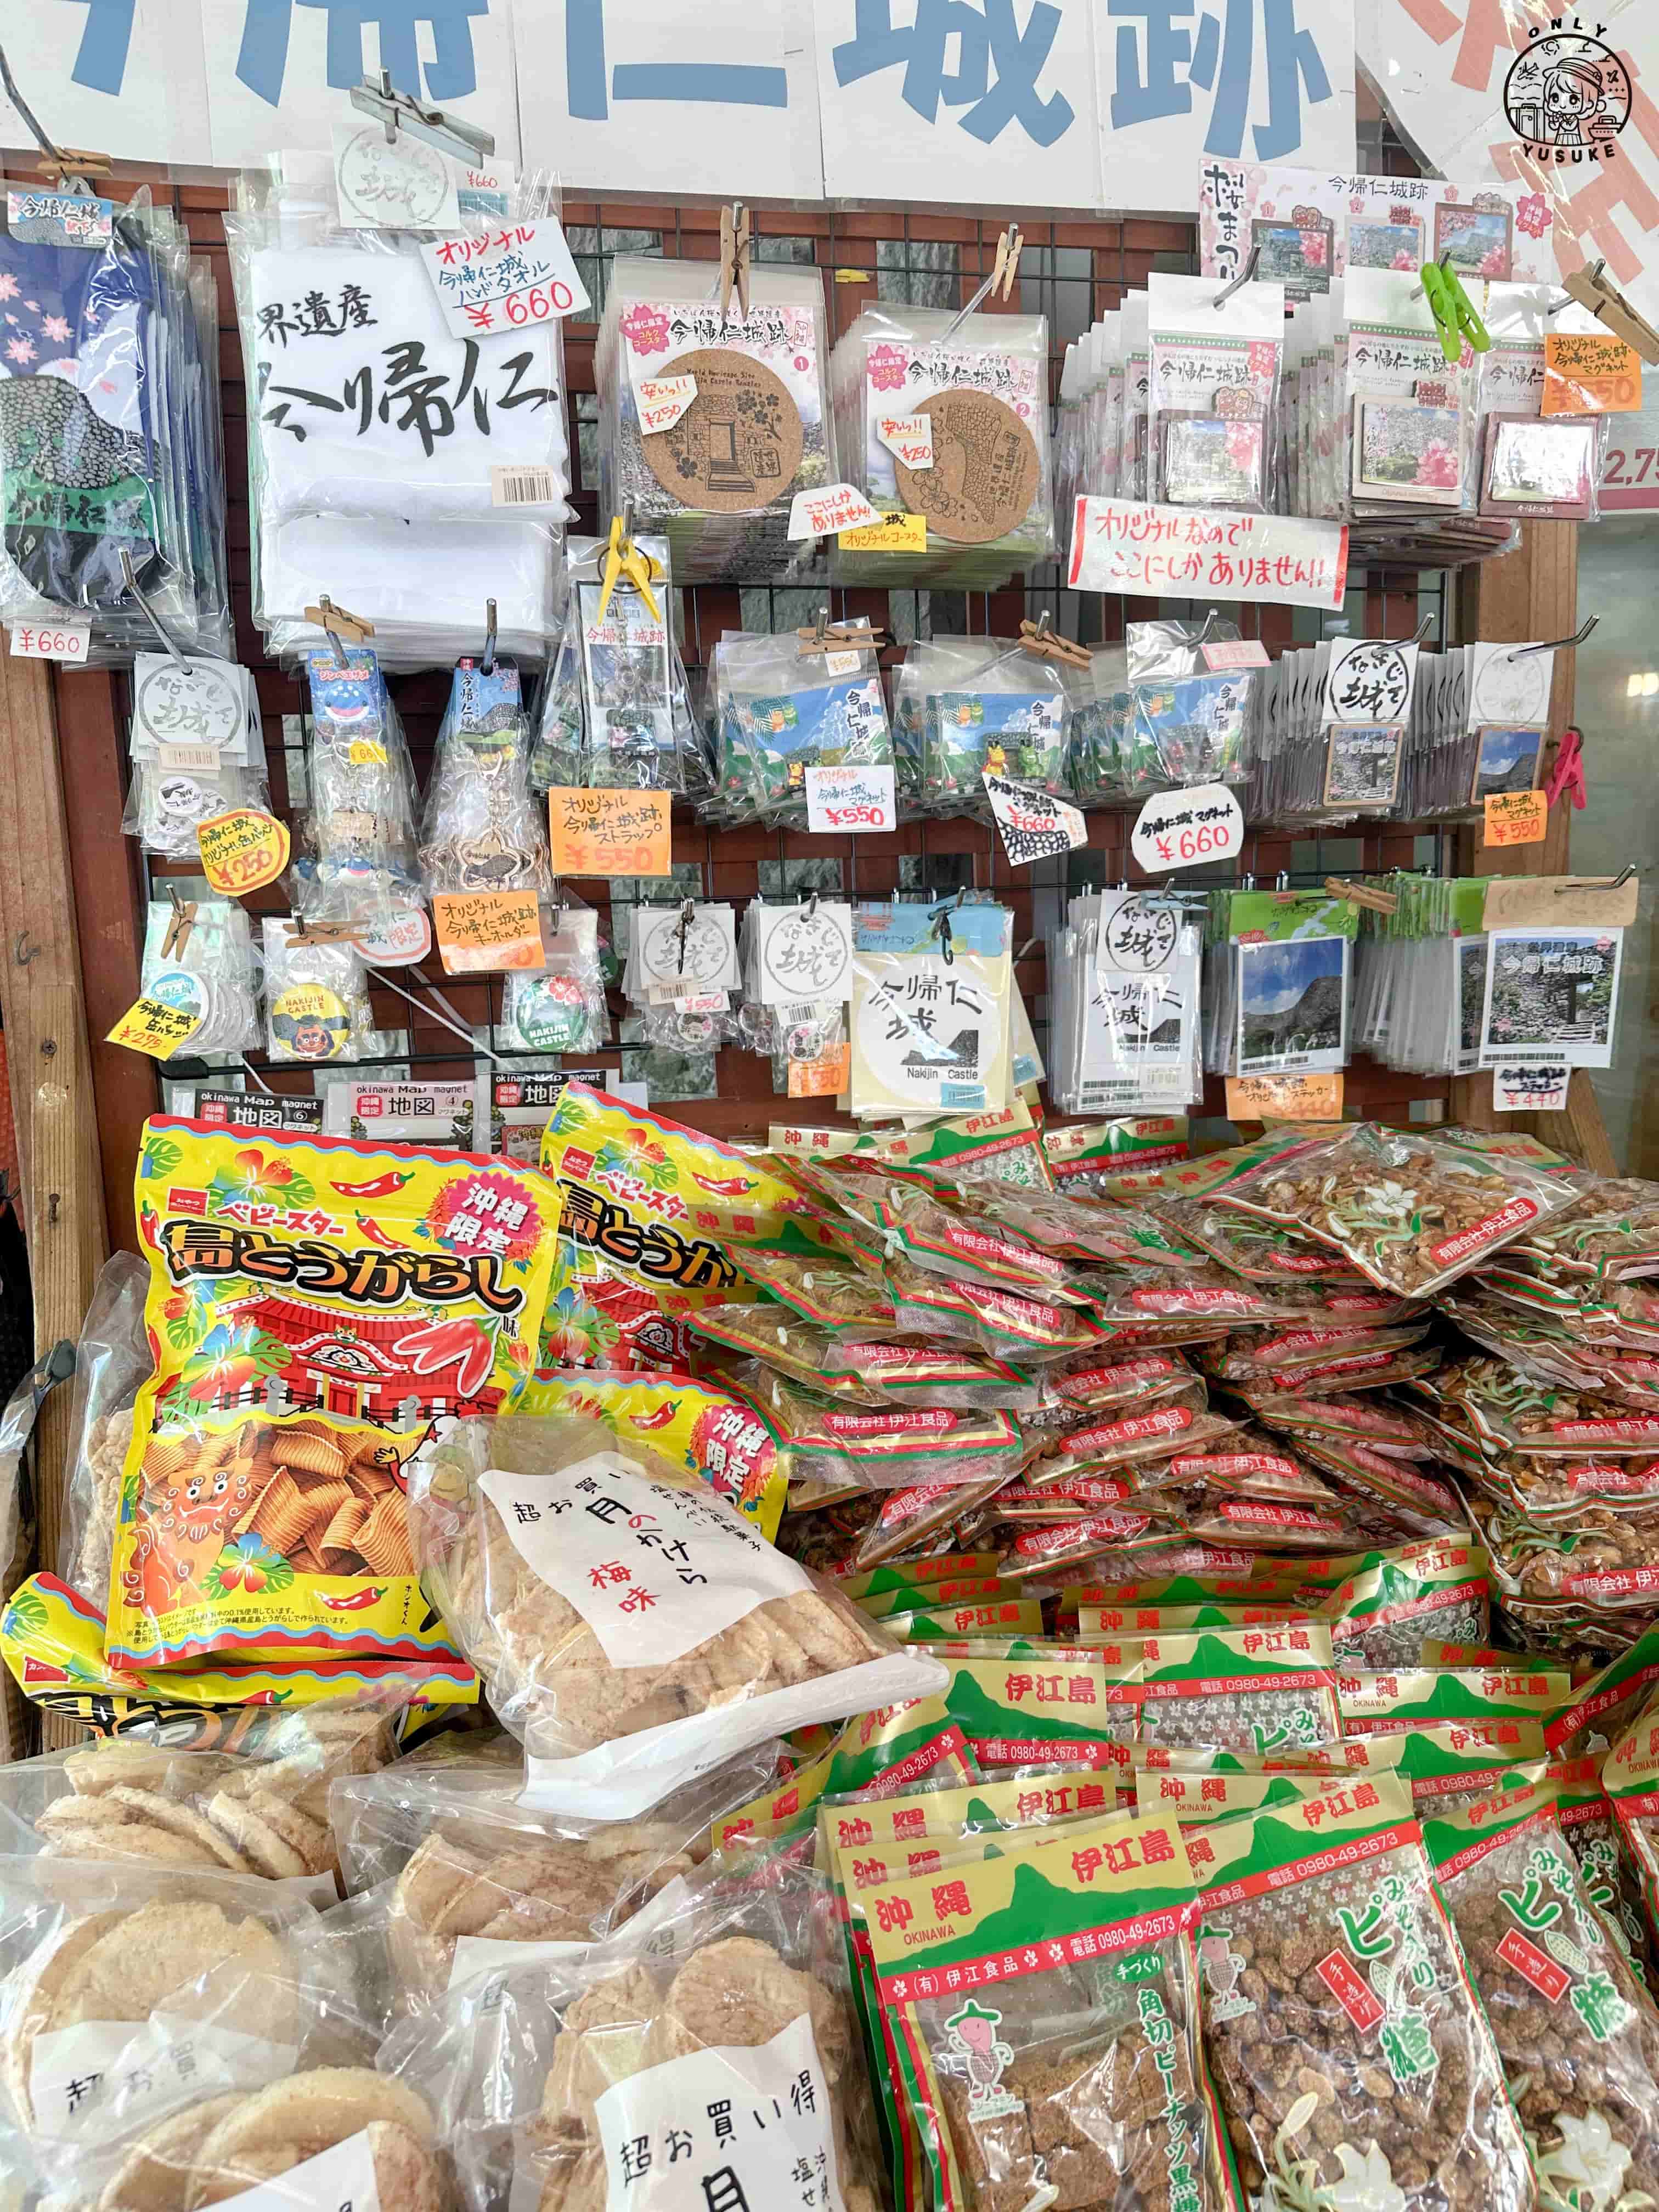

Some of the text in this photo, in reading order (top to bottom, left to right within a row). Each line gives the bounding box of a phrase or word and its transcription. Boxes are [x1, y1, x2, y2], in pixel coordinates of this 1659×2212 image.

[466, 170, 498, 189] ¥660
[1328, 175, 1429, 201] 今帰仁城跡
[435, 226, 536, 266] オリジナル
[439, 252, 527, 290] 今帰仁城
[459, 261, 551, 307] ハンドタオル
[464, 281, 573, 330] ¥660
[670, 318, 794, 345] 今帰仁城跡
[1553, 338, 1601, 352] オリジナル
[1555, 346, 1632, 366] 今帰仁城跡
[907, 359, 1017, 392] 今帰仁城跡
[1160, 360, 1251, 385] 今帰仁城跡
[1584, 363, 1629, 375] マグネット
[643, 405, 681, 429] ¥250
[900, 445, 932, 462] ¥250
[803, 489, 853, 515] ここにしか
[1094, 506, 1254, 549] オリジナルなので
[19, 628, 81, 654] ¥660
[319, 668, 369, 681] ジンベエザメ
[562, 795, 628, 812] オリジナル
[817, 782, 866, 801] 今帰仁城
[849, 789, 888, 805] マグネット
[563, 802, 663, 833] 今帰仁城跡
[826, 806, 884, 827] ¥550
[1007, 804, 1055, 832] ¥660
[1140, 803, 1233, 838] 今帰仁城 マグネット
[200, 815, 253, 850] 今帰仁城
[594, 823, 663, 844] ストラップ
[1155, 825, 1230, 861] ¥660
[1493, 819, 1540, 844] ¥550
[212, 848, 274, 888] ¥250
[565, 845, 654, 872] ¥550
[441, 899, 504, 919] オリジナル
[446, 905, 537, 939] 今帰仁城跡
[389, 922, 419, 949] 限定
[1503, 956, 1605, 974] 今帰仁城跡
[285, 995, 325, 1008] NAKIJIN
[287, 1001, 325, 1013] CASTLE
[870, 974, 983, 1015] 今帰仁
[138, 1000, 196, 1030] 今帰仁城
[145, 1018, 189, 1039] 缶バッジ
[528, 1026, 569, 1041] NAKIJIN
[533, 1032, 570, 1048] CASTLE
[1153, 1044, 1181, 1052] Castle
[496, 1073, 601, 1082] okinawa magnet
[906, 1066, 979, 1081] Nakijin Castle
[201, 1092, 318, 1111] okinawa Map magnet
[357, 1085, 469, 1096] okinawa Map magnet
[498, 1085, 521, 1096] 沖縄
[498, 1096, 521, 1105] 限定
[1506, 1091, 1560, 1107] ¥440
[202, 1103, 282, 1128] 沖縄 地図
[202, 1113, 225, 1122] 限定
[360, 1096, 435, 1117] 沖縄 地図
[360, 1107, 381, 1116] 限定
[966, 1112, 1014, 1135] 伊江島
[1046, 1119, 1175, 1150] 沖縄 伊江島
[785, 1130, 830, 1148] 沖縄
[958, 1135, 1025, 1162] 0980-49-2673
[463, 1182, 524, 1230] 沖縄
[596, 1171, 689, 1220] ベビースター
[215, 1201, 345, 1236] ベビースター
[444, 1212, 509, 1254] 限定
[952, 1232, 1001, 1252] 有限会社
[1438, 1203, 1532, 1261] 有限会社 伊江食品
[166, 1220, 525, 1313] 島とうがらし
[503, 1318, 520, 1339] 味
[1104, 1359, 1165, 1386] 伊江食品
[831, 1412, 949, 1429] 有限会社 伊江食品
[1066, 1409, 1183, 1451] 有限会社 伊江食品
[715, 1408, 770, 1459] 沖縄
[705, 1437, 750, 1493] 限定
[1234, 1455, 1293, 1474] 伊江食品
[1577, 1470, 1630, 1486] 有限会社
[887, 1481, 945, 1519] 有限会社
[1228, 1504, 1278, 1521] 有限会社
[585, 1496, 708, 1584] 月のかけら
[1022, 1526, 1079, 1553] 有限会社
[1415, 1549, 1469, 1577] 伊江島
[588, 1561, 662, 1613] 梅味
[1570, 1577, 1632, 1596] 有限会社
[1406, 1585, 1474, 1615] 0980-49-2673
[954, 1604, 1022, 1633] 伊江島
[1100, 1609, 1161, 1631] 沖縄
[1243, 1630, 1311, 1654] 伊江島
[1005, 1672, 1097, 1704] 伊江島
[1199, 1674, 1317, 1694] 電話 0980-49-2673
[1339, 1676, 1549, 1699] 沖縄 伊江島
[1352, 1699, 1387, 1708] OKINAWA
[1563, 1690, 1620, 1732] (有) 伊江食品
[1344, 1721, 1365, 1734] (有)
[1450, 1726, 1521, 1751] 伊江島
[985, 1743, 1079, 1760] 電話 0980-49-2673
[876, 1745, 939, 1794] 0980-49-2673
[1160, 1777, 1227, 1803] 沖縄
[1414, 1781, 1439, 1795] 電話
[1017, 1783, 1107, 1823] 伊江島
[1176, 1802, 1213, 1813] OKINAWA
[1303, 1781, 1380, 1827] 伊江島
[1467, 1785, 1535, 1825] 伊江島
[838, 1807, 926, 1847] 沖縄
[1267, 1832, 1398, 1886] 電話 0980-49-2673
[875, 1827, 1176, 1933] 沖縄 伊江島
[904, 1923, 956, 1946] OKINAWA
[912, 1915, 1176, 1995] (有) 伊江食品 電話 0980-49-2673
[620, 2069, 816, 2188] 超お買い得
